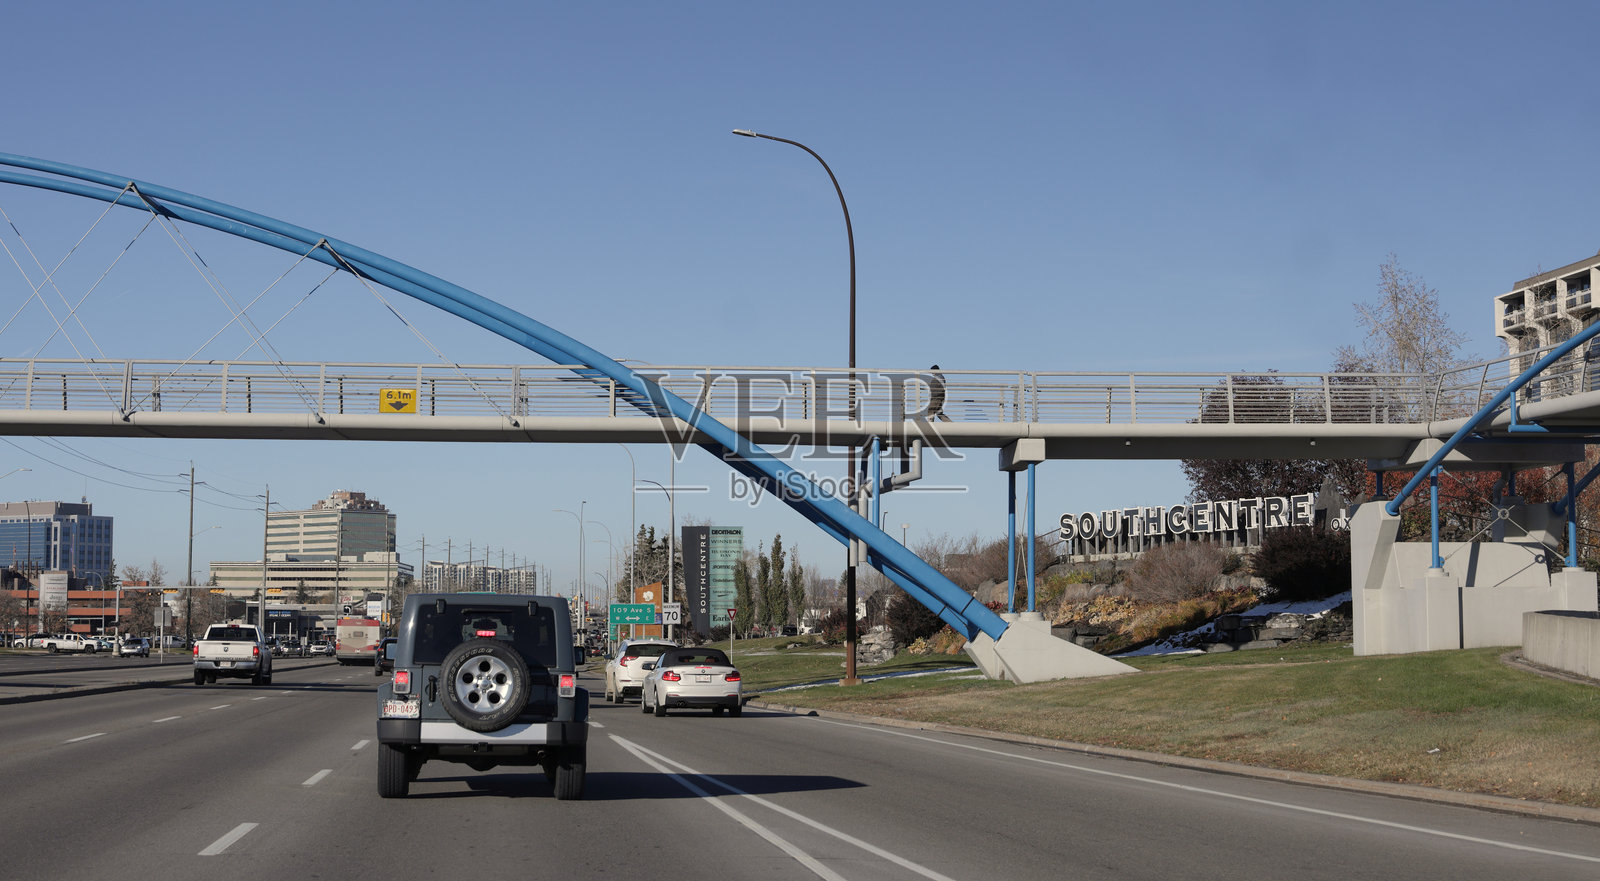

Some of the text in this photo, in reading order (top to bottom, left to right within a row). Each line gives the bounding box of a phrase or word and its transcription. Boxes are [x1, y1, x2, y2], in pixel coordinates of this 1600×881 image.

[386, 391, 412, 400] 6.1m
[1059, 492, 1315, 542] SOUTHCENTRE
[664, 611, 679, 621] 70
